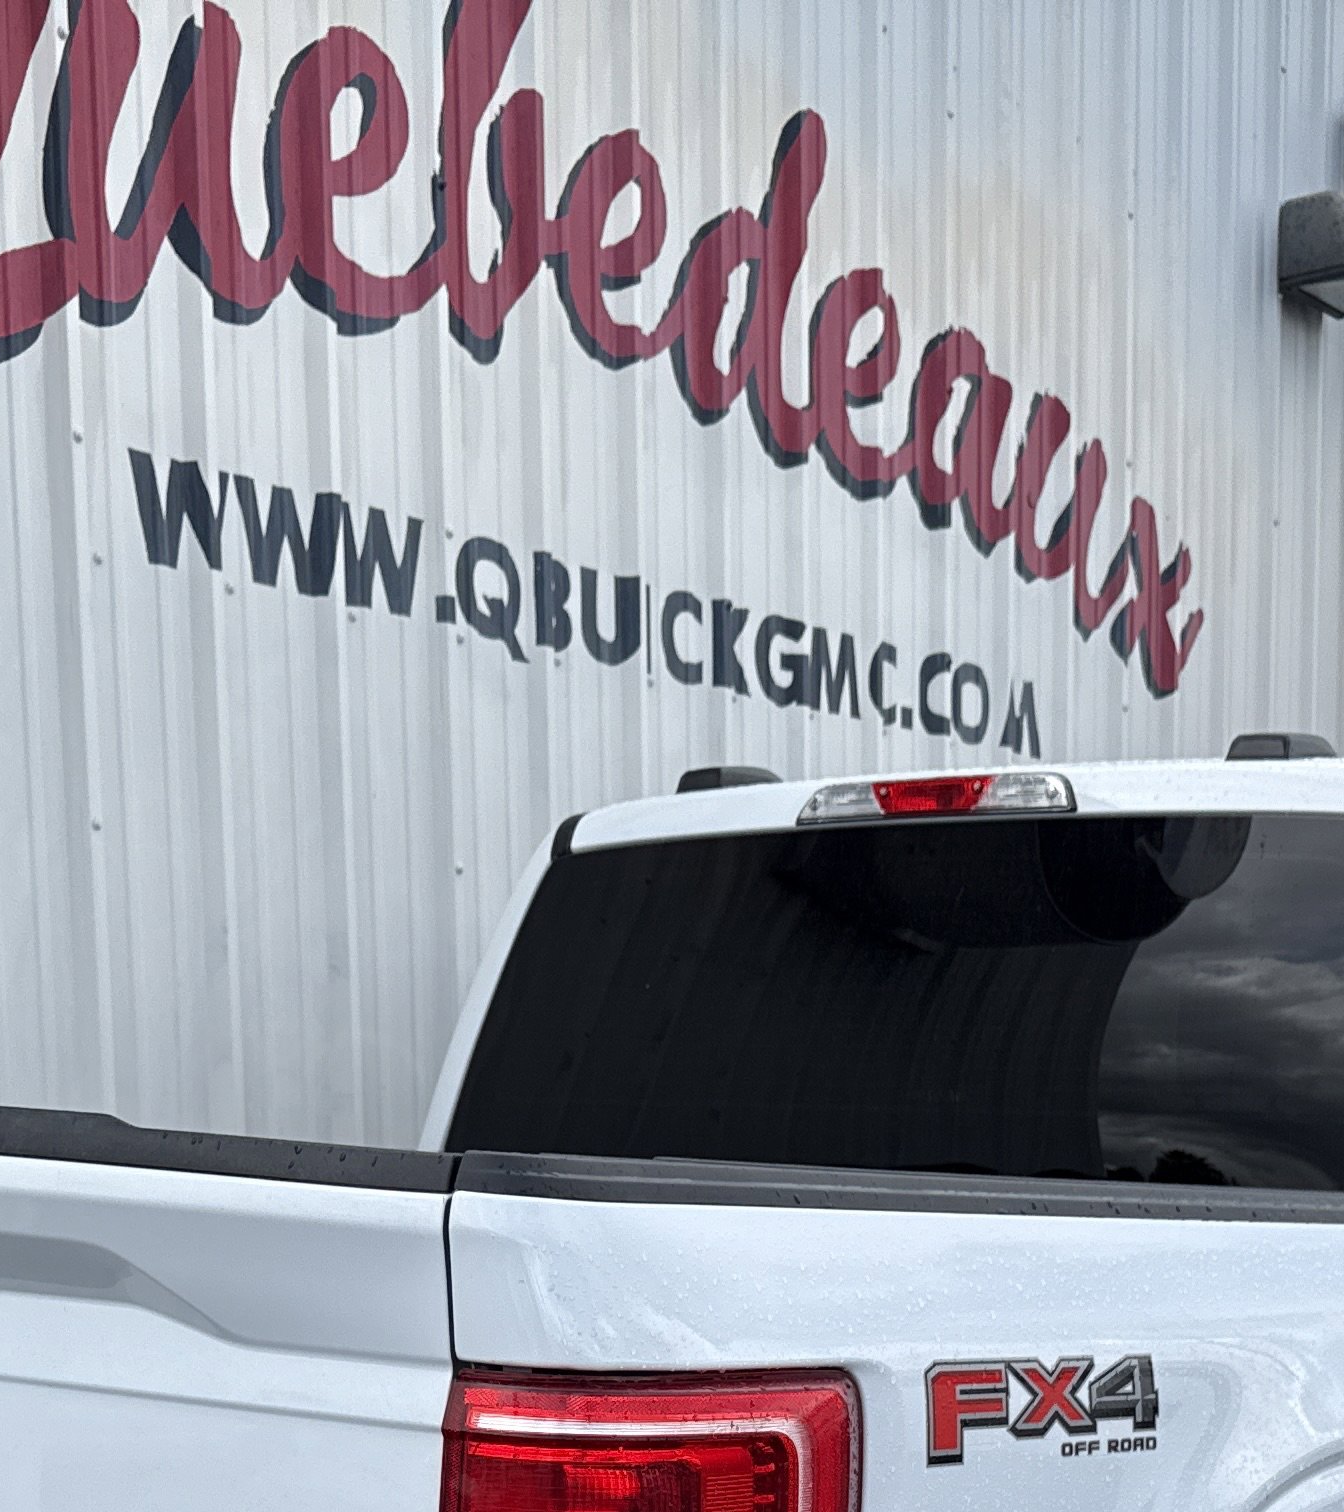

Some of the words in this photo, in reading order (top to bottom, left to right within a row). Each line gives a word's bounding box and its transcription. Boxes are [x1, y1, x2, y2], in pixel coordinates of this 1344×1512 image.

[127, 447, 1042, 759] WWW.QBUICKGMC.COM
[924, 1353, 1159, 1468] FX4
[1061, 1440, 1100, 1457] OFF
[1107, 1436, 1157, 1454] ROAD
